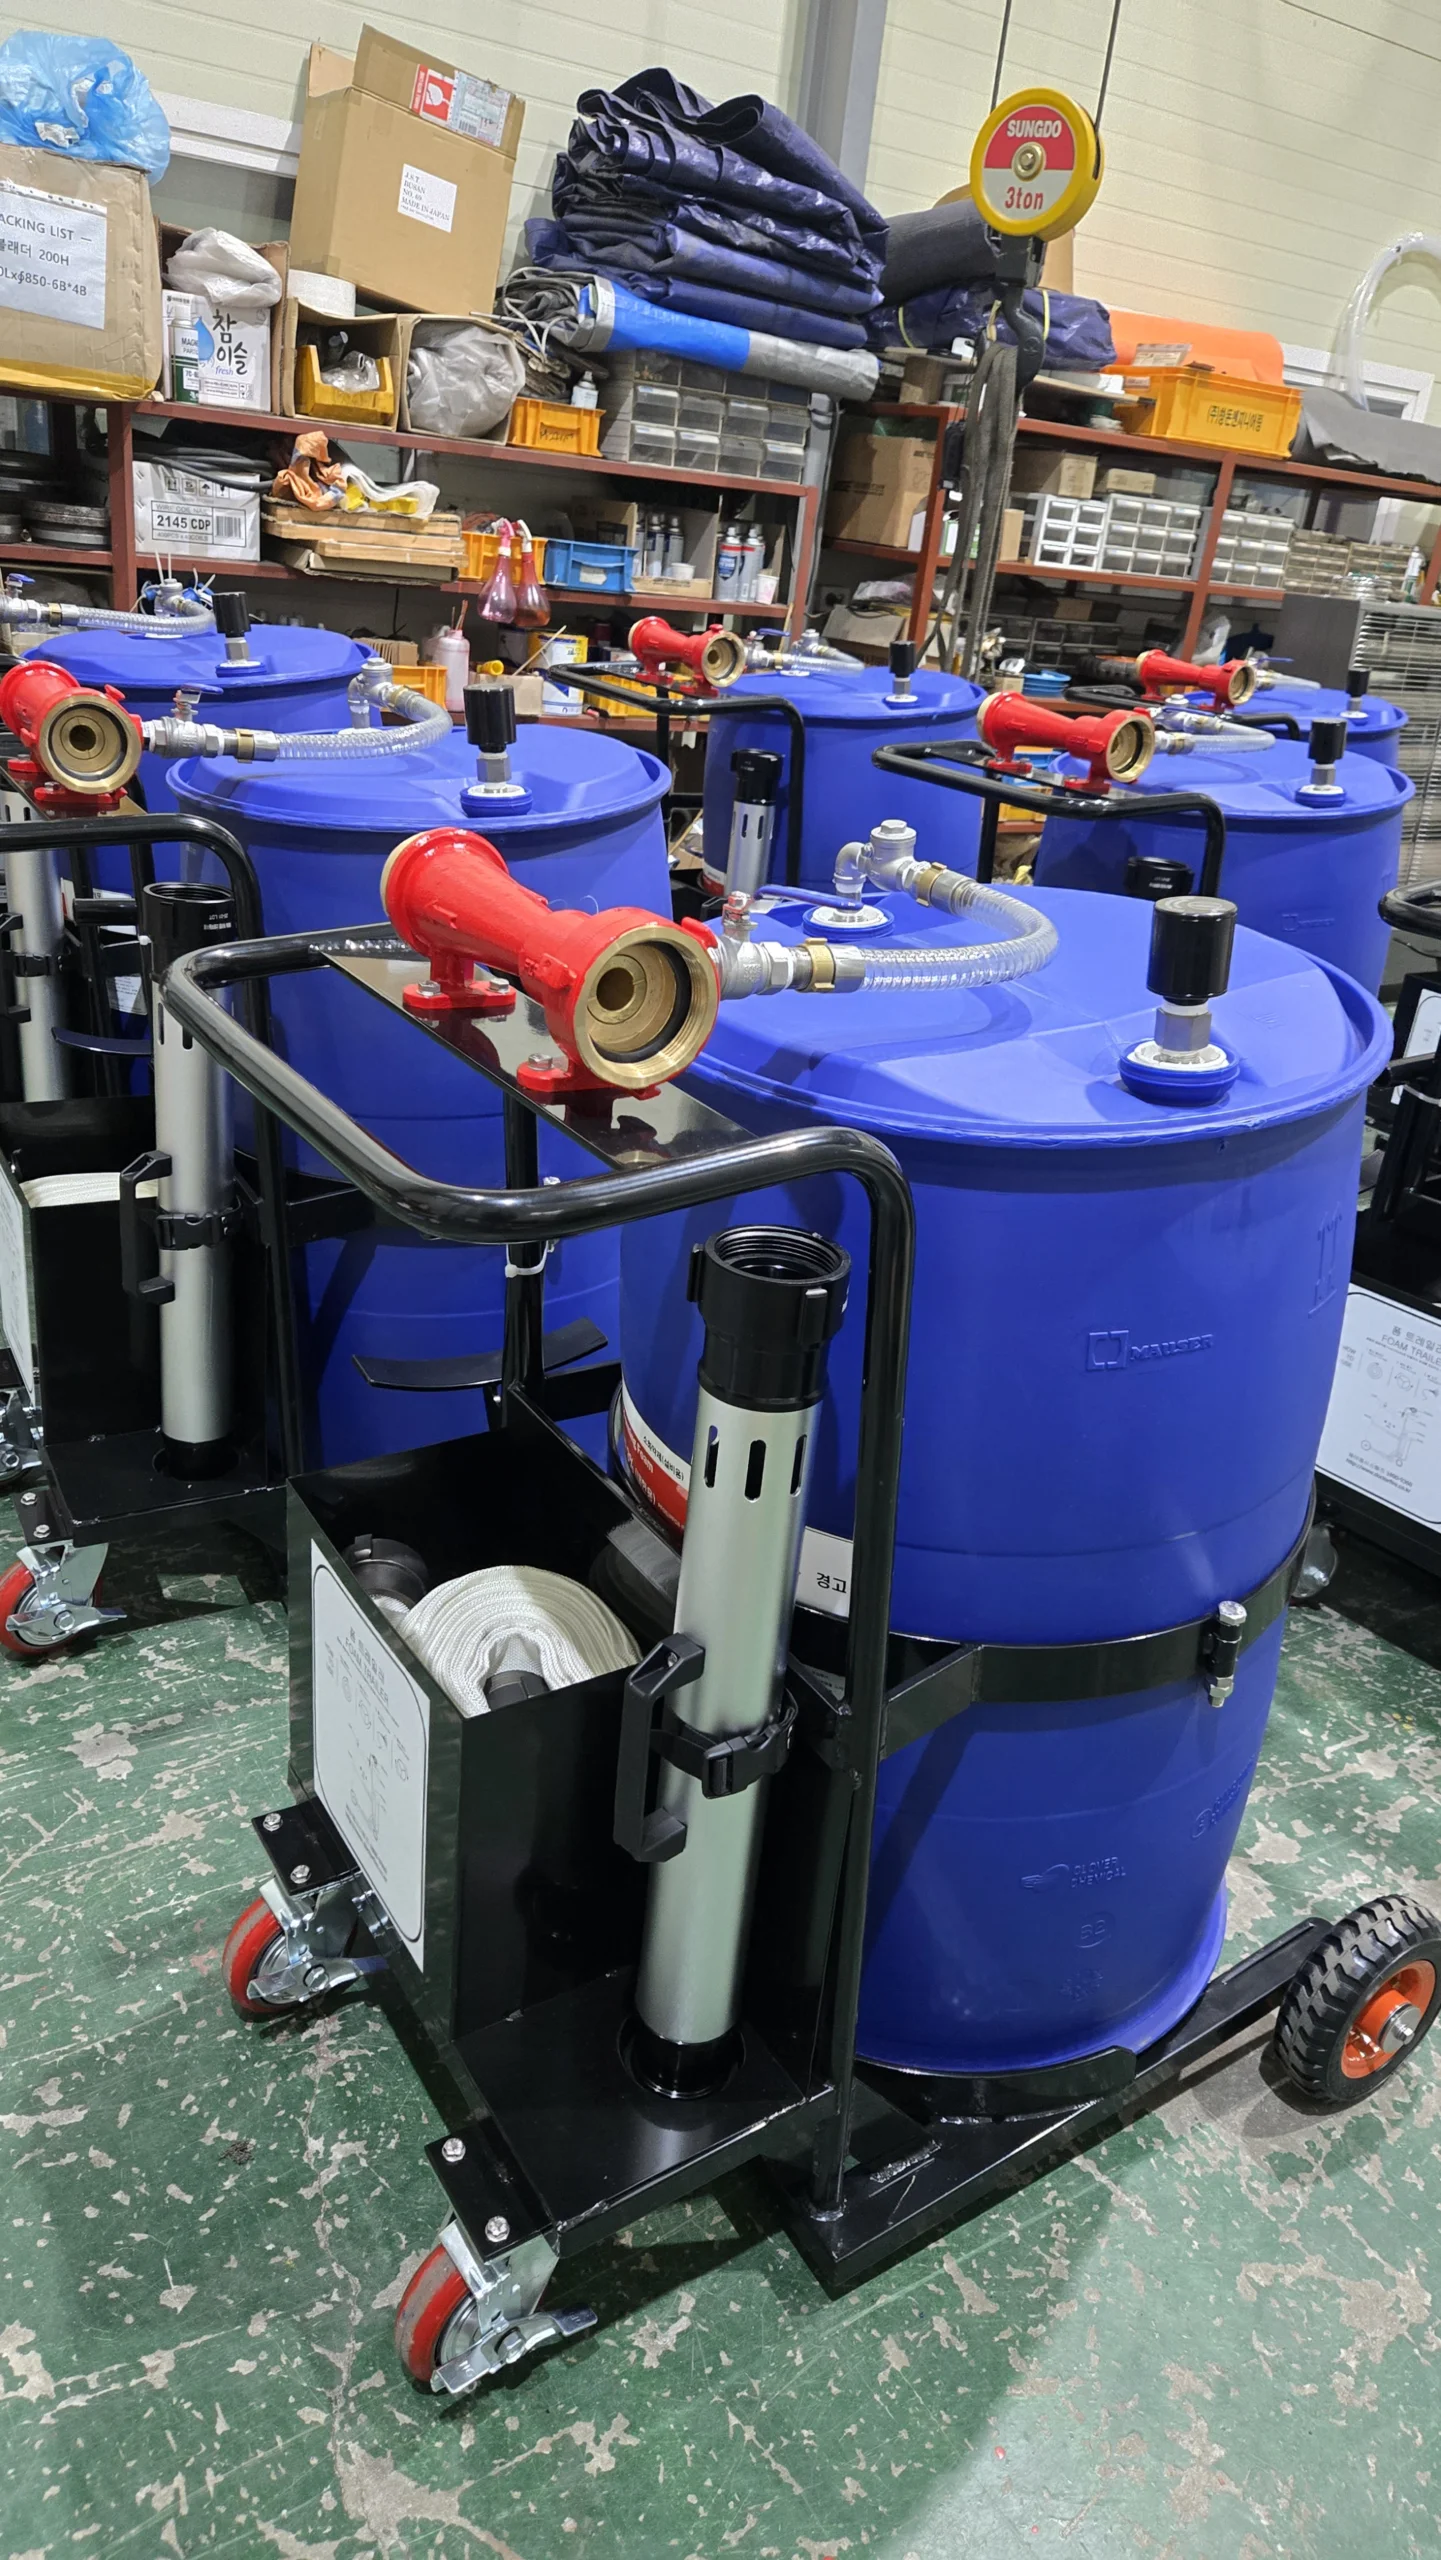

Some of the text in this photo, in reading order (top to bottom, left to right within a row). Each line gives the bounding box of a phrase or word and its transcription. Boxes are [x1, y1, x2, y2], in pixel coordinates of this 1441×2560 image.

[1006, 119, 1062, 138] SUNGDO
[1004, 185, 1044, 210] 3ton
[401, 196, 420, 210] MADE
[421, 204, 429, 213] IN
[429, 208, 450, 221] JAPAN
[50, 225, 75, 241] LIST
[39, 249, 70, 266] 200H
[215, 365, 234, 376] fresh
[156, 514, 211, 531] 2145 CDP
[1130, 1333, 1214, 1361] MAUSER
[1381, 1334, 1408, 1352] FOAM
[816, 1571, 848, 1594] 경고
